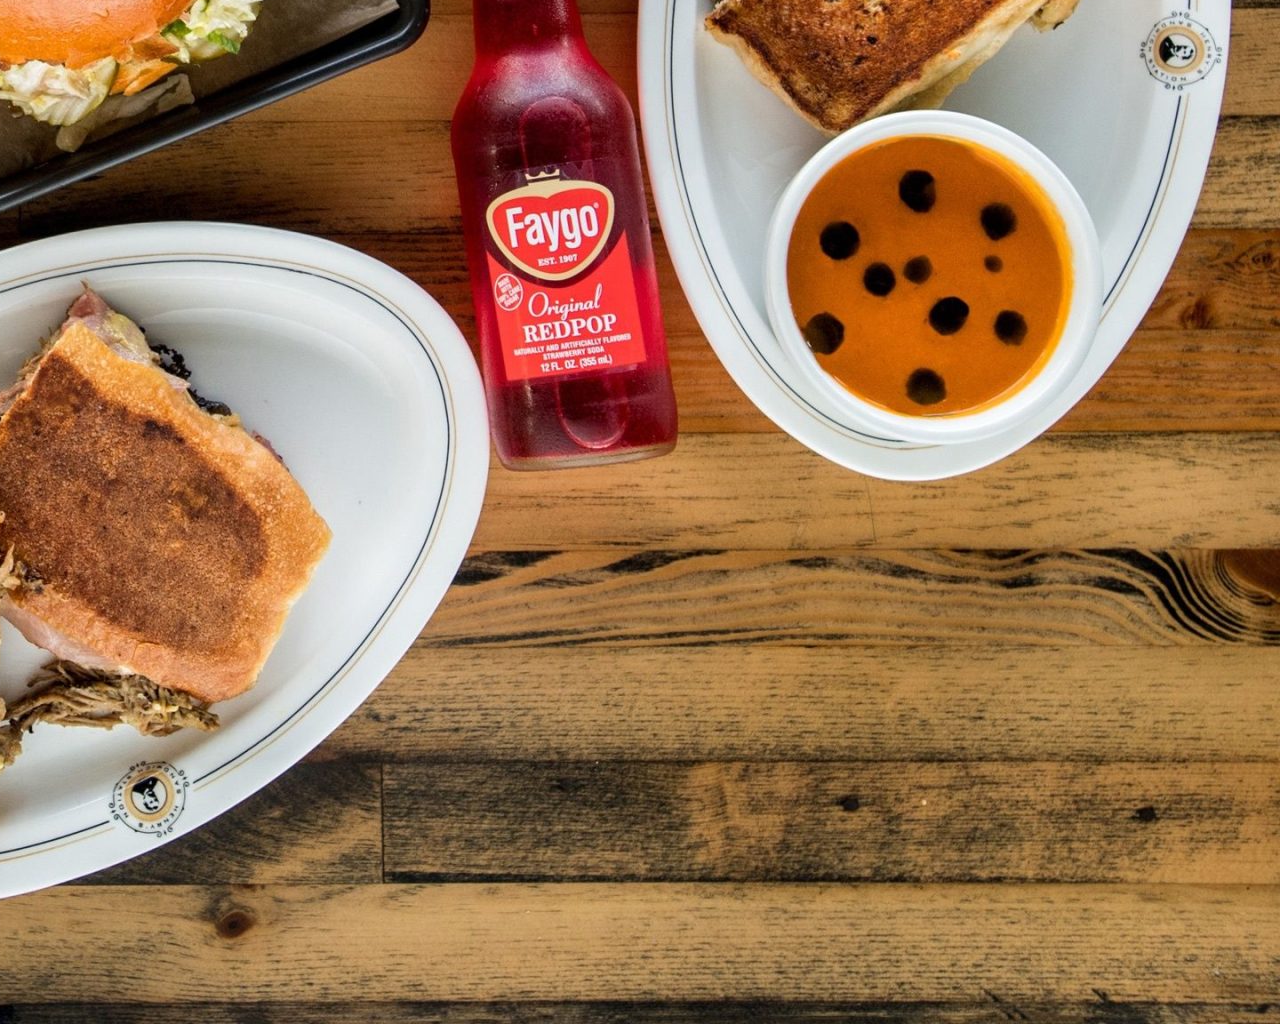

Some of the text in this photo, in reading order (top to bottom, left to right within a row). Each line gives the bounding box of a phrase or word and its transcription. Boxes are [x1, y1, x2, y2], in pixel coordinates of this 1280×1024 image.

[505, 204, 599, 252] Faygo
[537, 254, 578, 267] EST. 1907
[528, 283, 602, 321] Original
[523, 313, 617, 345] REDPOP
[513, 333, 632, 357] NATURALLY AND ARTIFICIALLY FLAVORED
[543, 345, 605, 361] STRAWBERRY SODA
[540, 362, 551, 373] 12
[579, 357, 598, 369] (355
